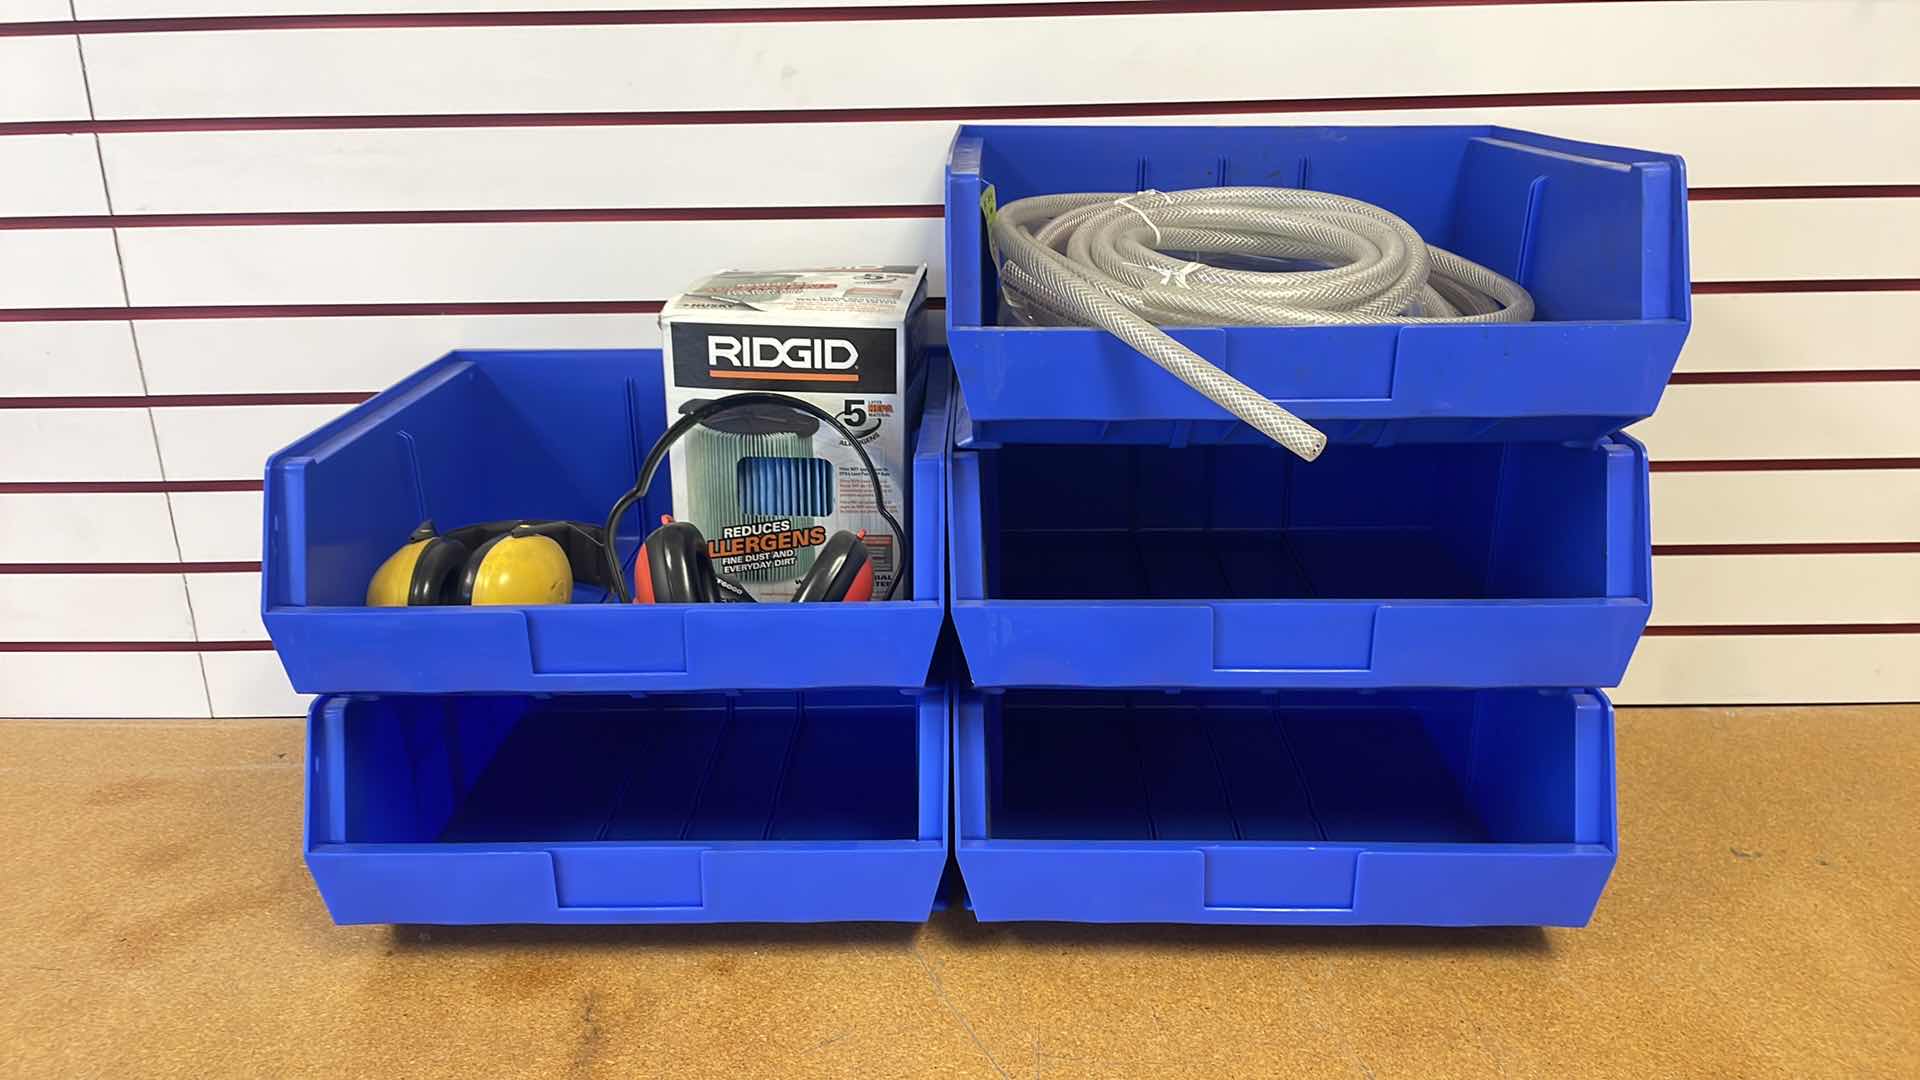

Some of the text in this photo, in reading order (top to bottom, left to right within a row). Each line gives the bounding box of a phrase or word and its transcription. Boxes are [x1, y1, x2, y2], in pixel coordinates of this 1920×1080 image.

[707, 335, 859, 370] RIDGID
[844, 399, 867, 427] 5
[724, 520, 790, 539] REDUCES
[706, 526, 826, 558] LLERGENS
[722, 549, 794, 566] FINE DUST AND
[723, 557, 796, 574] EVERYDAY DIRT
